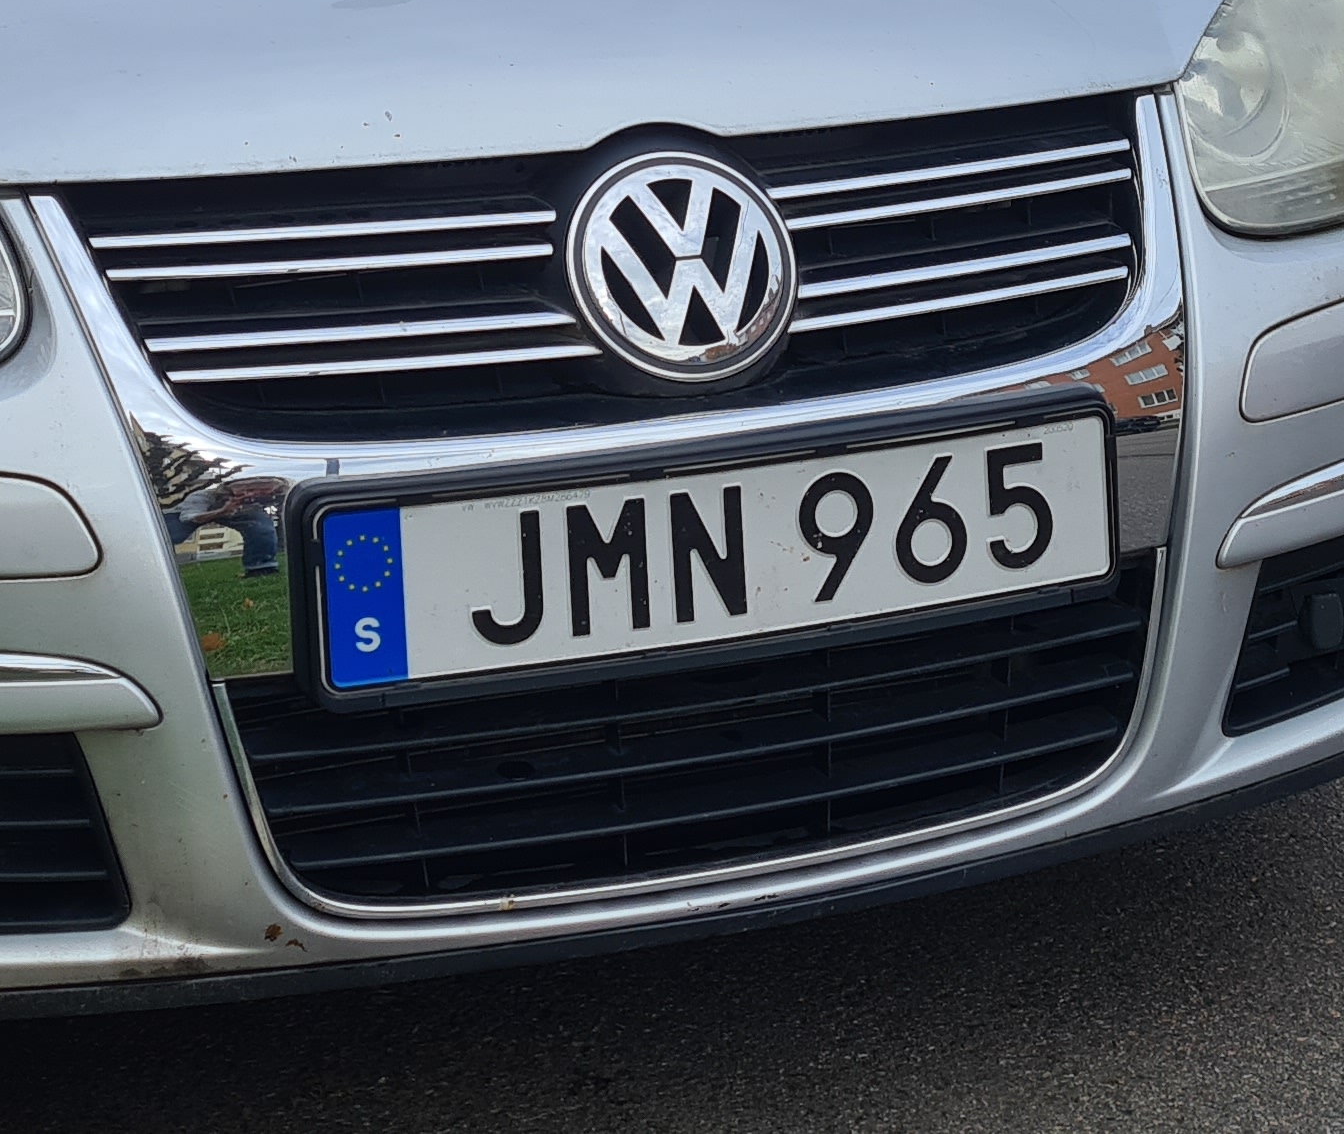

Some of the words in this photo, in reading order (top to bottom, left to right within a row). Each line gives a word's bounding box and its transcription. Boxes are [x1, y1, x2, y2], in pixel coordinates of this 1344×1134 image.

[580, 164, 783, 365] VW
[354, 616, 382, 653] S
[470, 485, 749, 647] JMN
[798, 441, 1054, 603] 965
